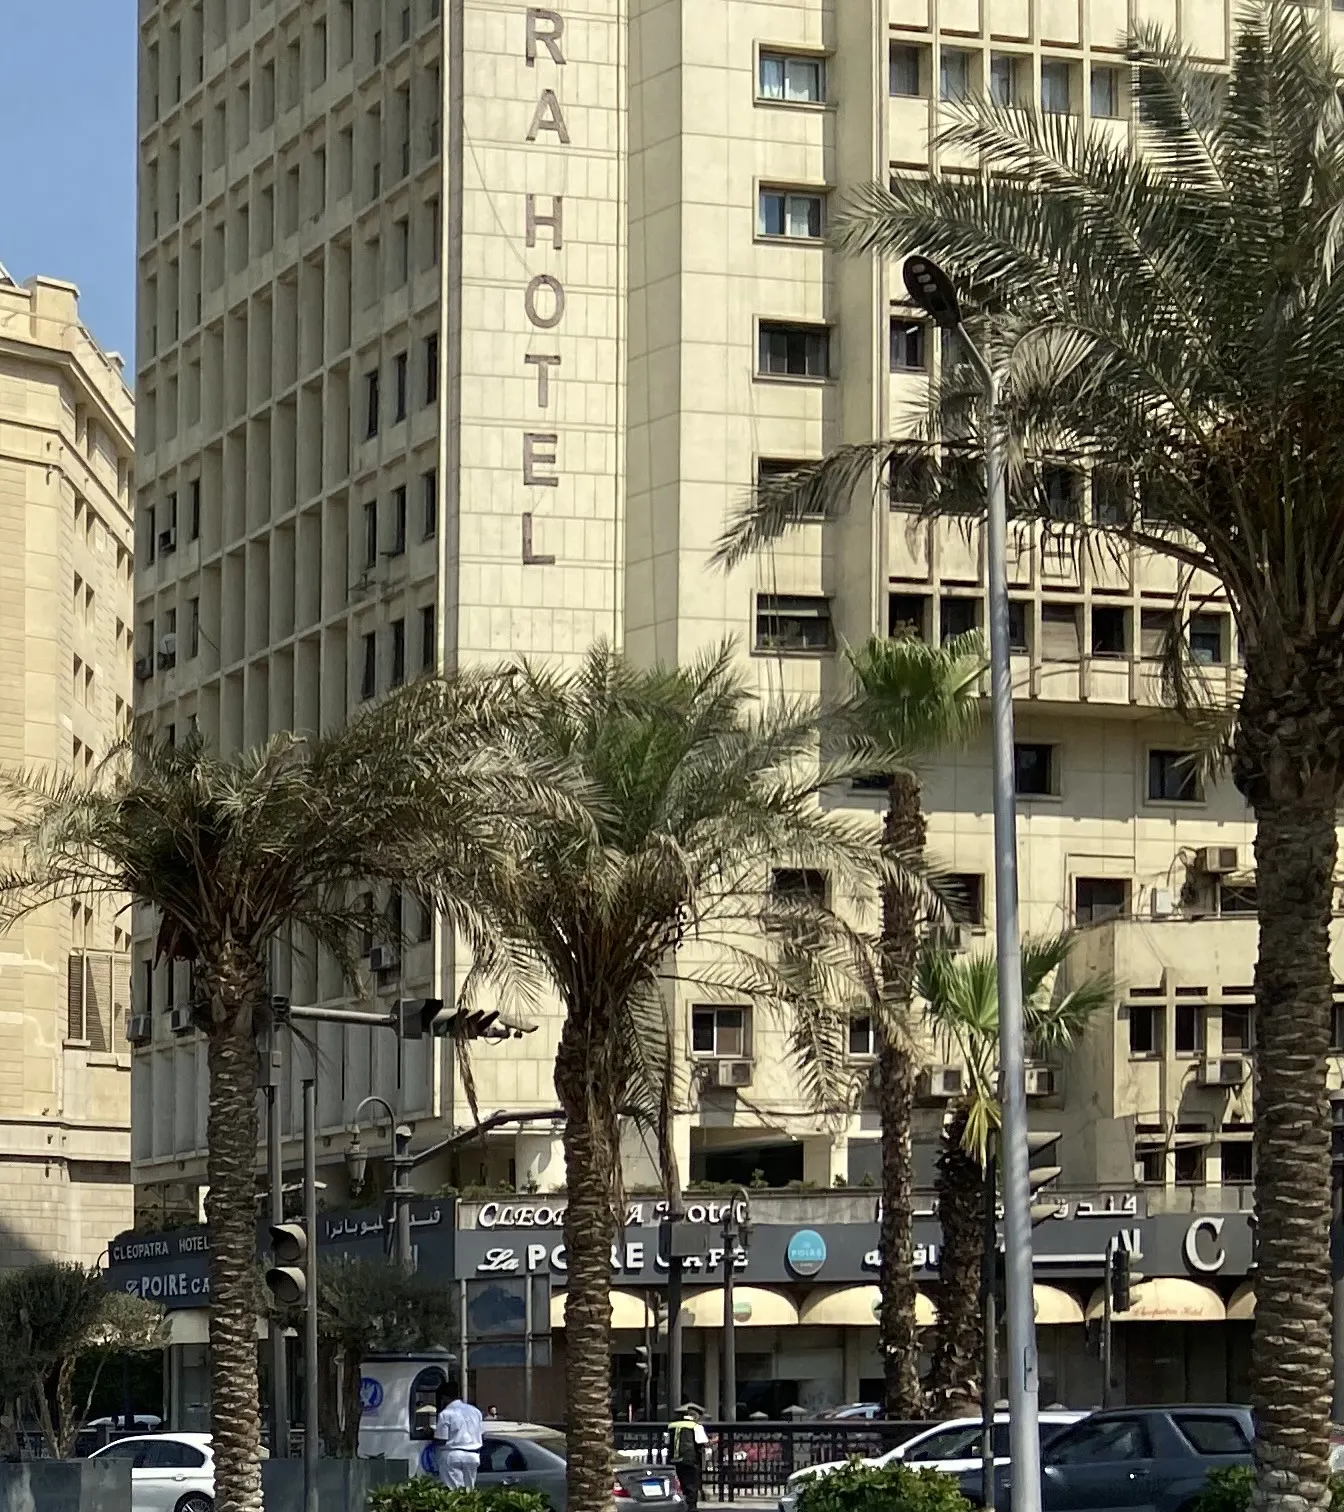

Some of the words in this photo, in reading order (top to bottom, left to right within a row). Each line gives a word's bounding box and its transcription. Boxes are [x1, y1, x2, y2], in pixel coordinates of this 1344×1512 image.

[522, 194, 566, 565] HOTEL
[325, 1214, 384, 1240] ليوباترا
[113, 1241, 169, 1260] CLEOPATRA
[179, 1235, 210, 1253] HOTEL
[141, 1273, 187, 1297] POIRE
